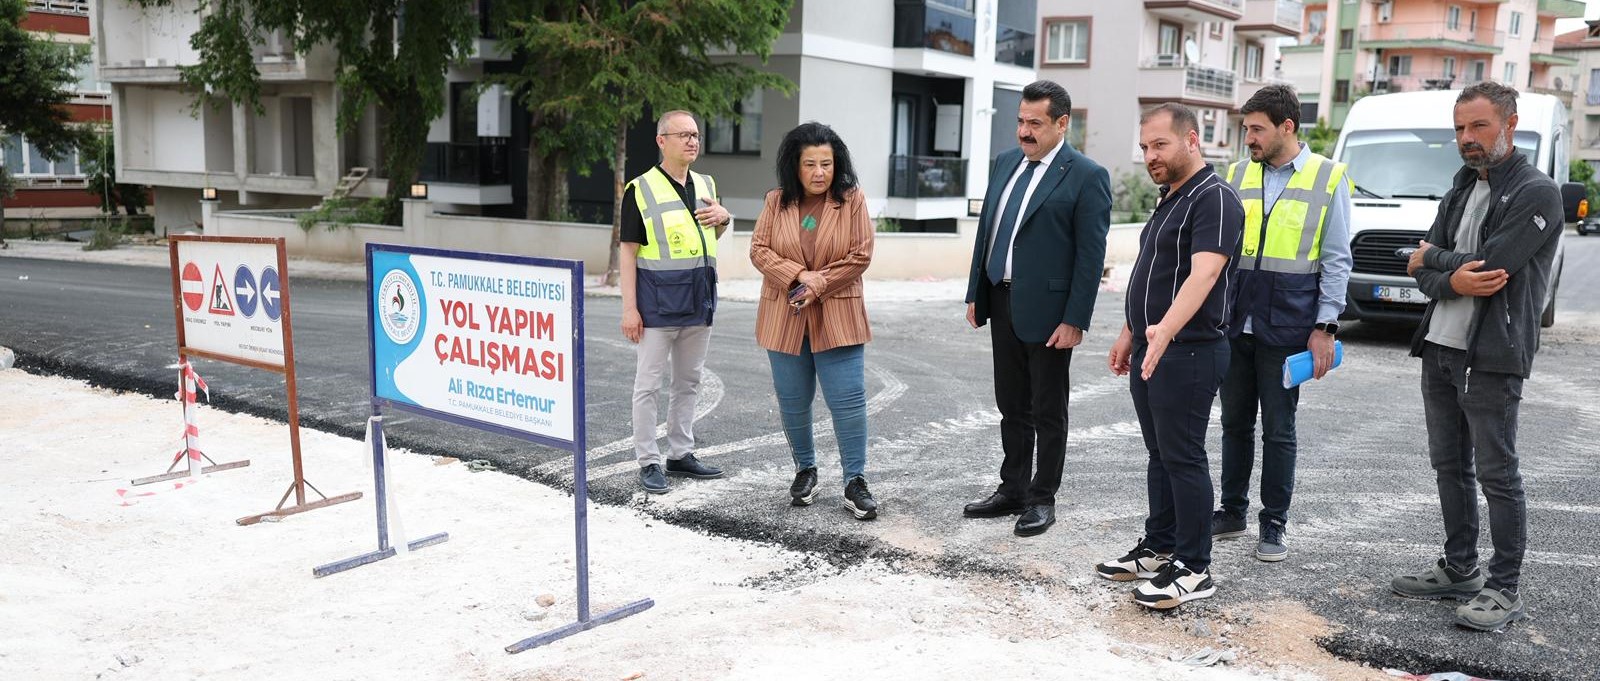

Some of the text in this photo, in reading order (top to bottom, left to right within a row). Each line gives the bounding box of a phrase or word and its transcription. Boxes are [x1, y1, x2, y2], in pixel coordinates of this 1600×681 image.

[430, 271, 565, 301] T.C. PAMUKKALE BELEDİYESİ
[1379, 287, 1411, 299] 20 BS
[440, 299, 554, 342] YOL YAPIM
[434, 333, 564, 382] ÇALIŞMASI
[448, 377, 555, 414] Ali Rıza Ertemur
[459, 400, 494, 415] PAMUKKALE
